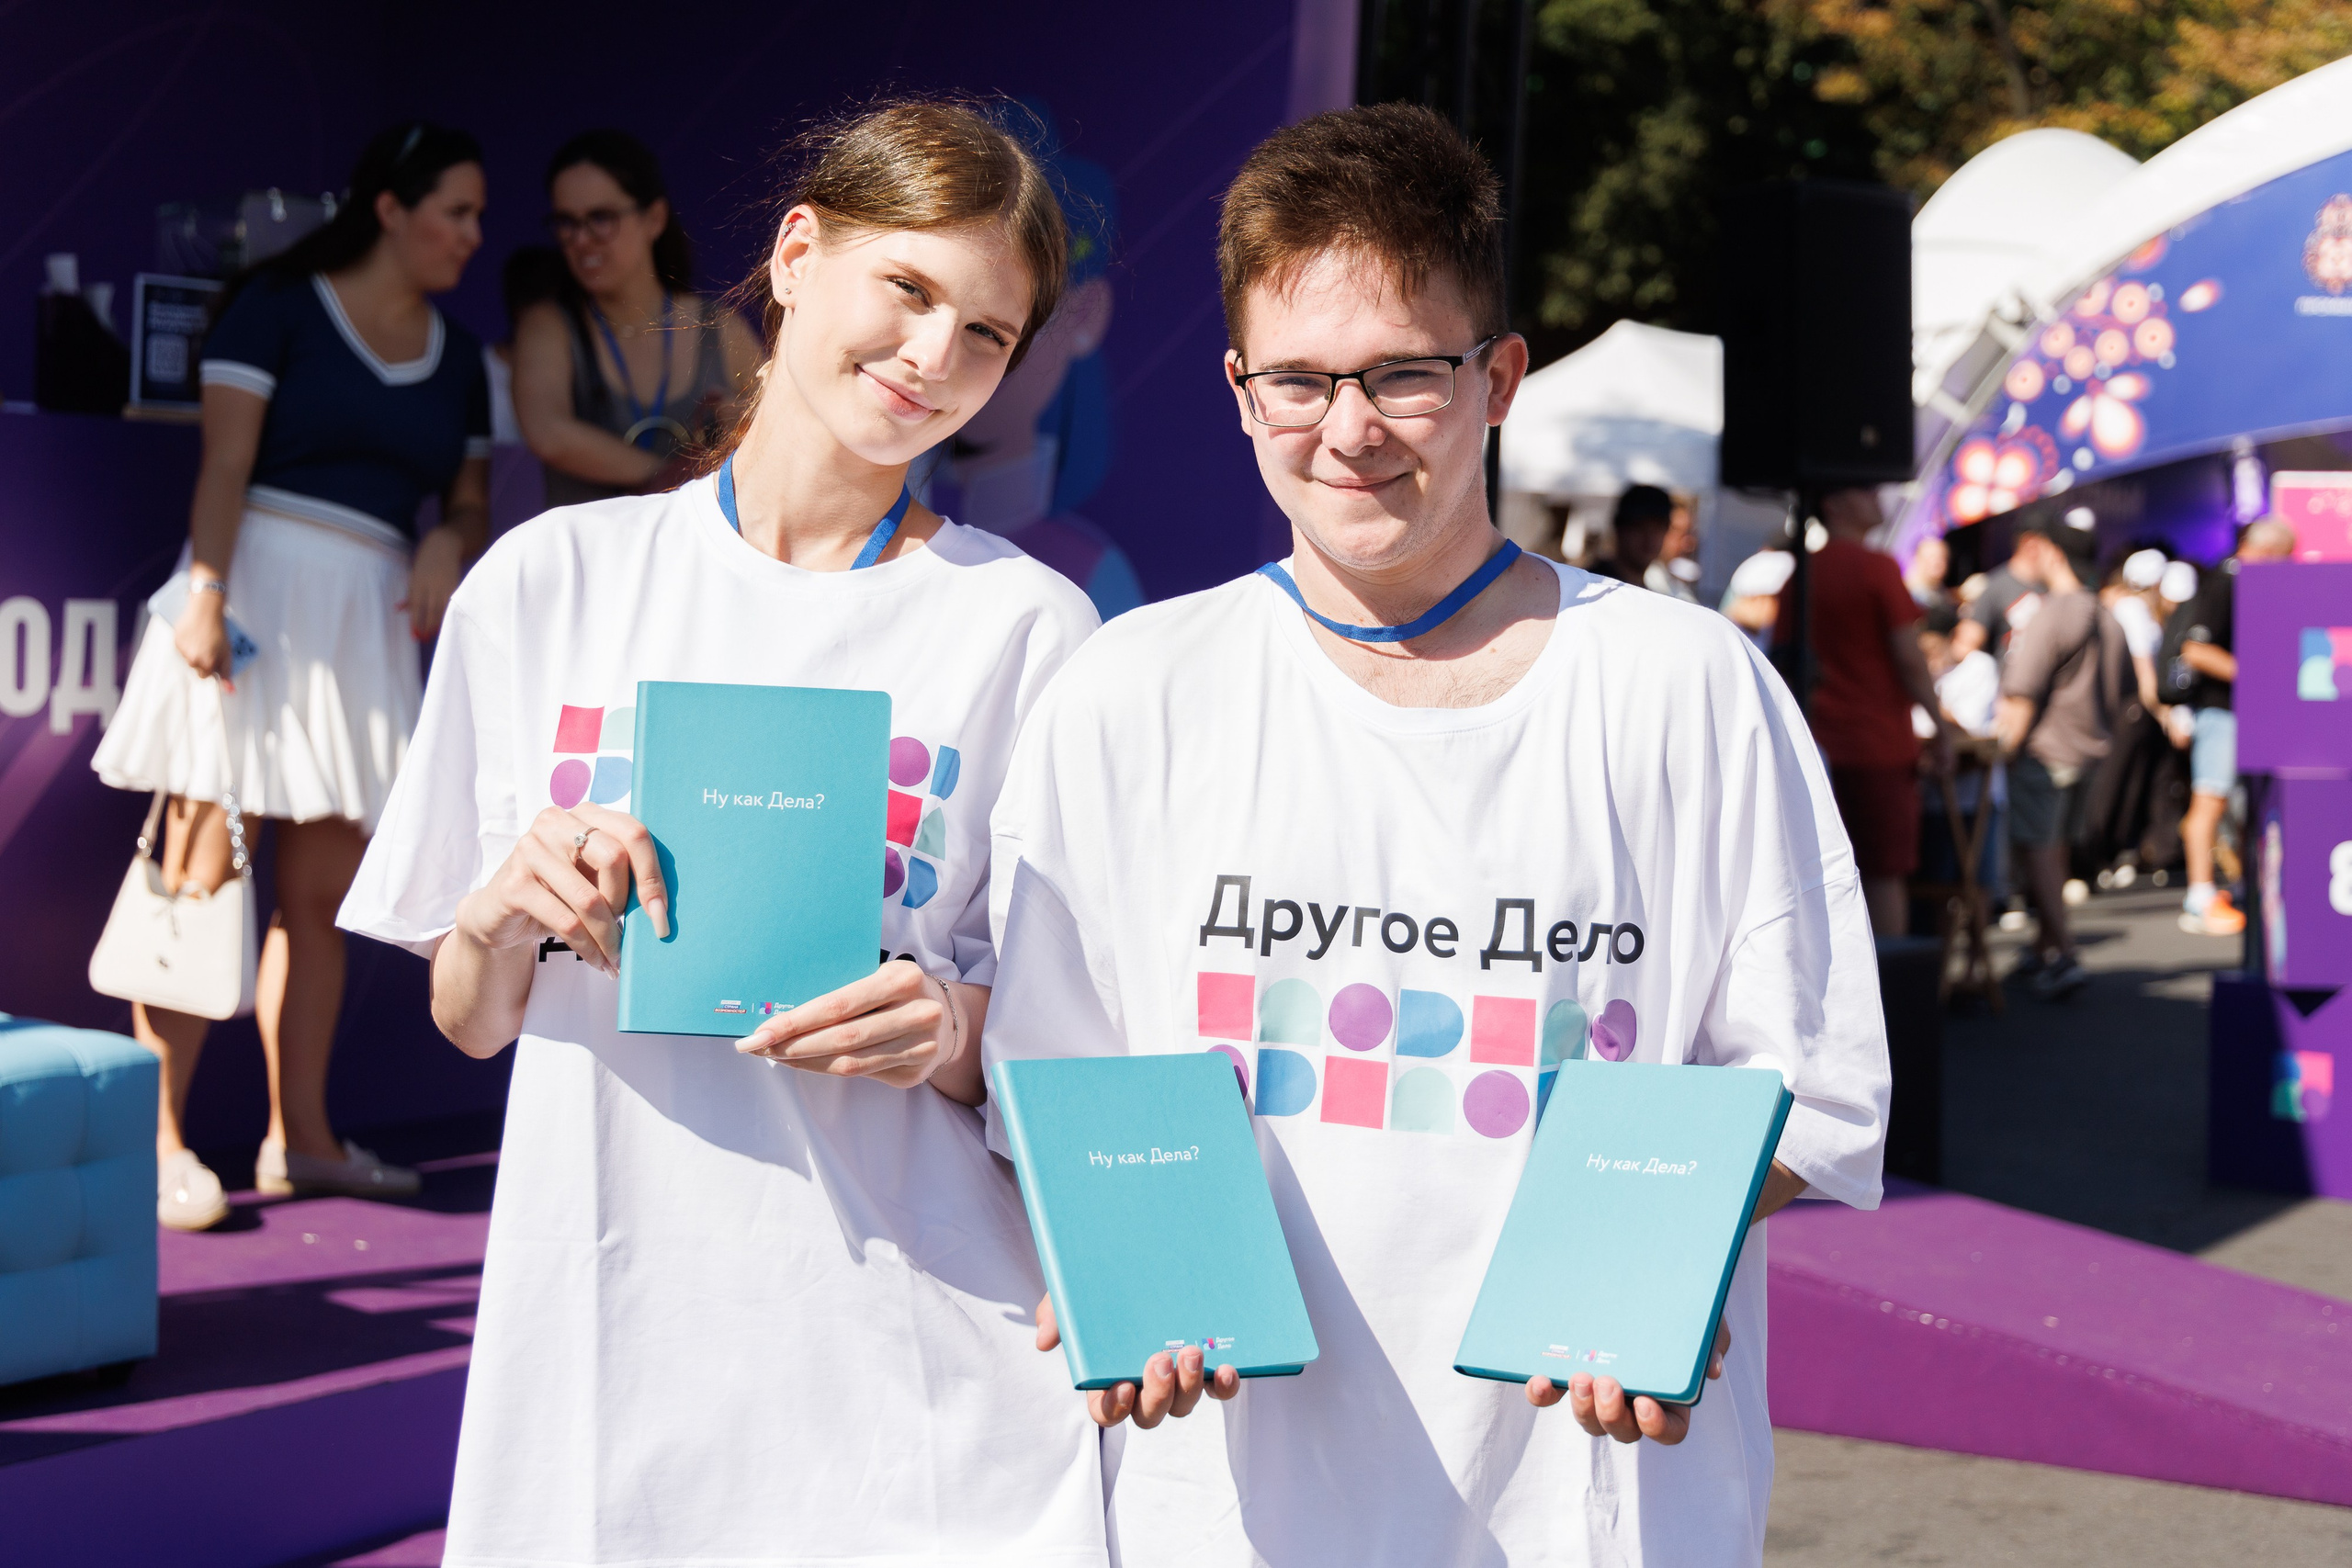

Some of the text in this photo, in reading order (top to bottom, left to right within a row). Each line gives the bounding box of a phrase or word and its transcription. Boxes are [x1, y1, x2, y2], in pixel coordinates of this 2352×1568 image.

[0, 595, 152, 735] ОД
[703, 788, 825, 810] Ну как Дела?
[1199, 874, 1645, 972] Другое Дело
[1089, 1145, 1200, 1168] Ну как Дела?
[1586, 1154, 1697, 1175] Ну как Дела?
